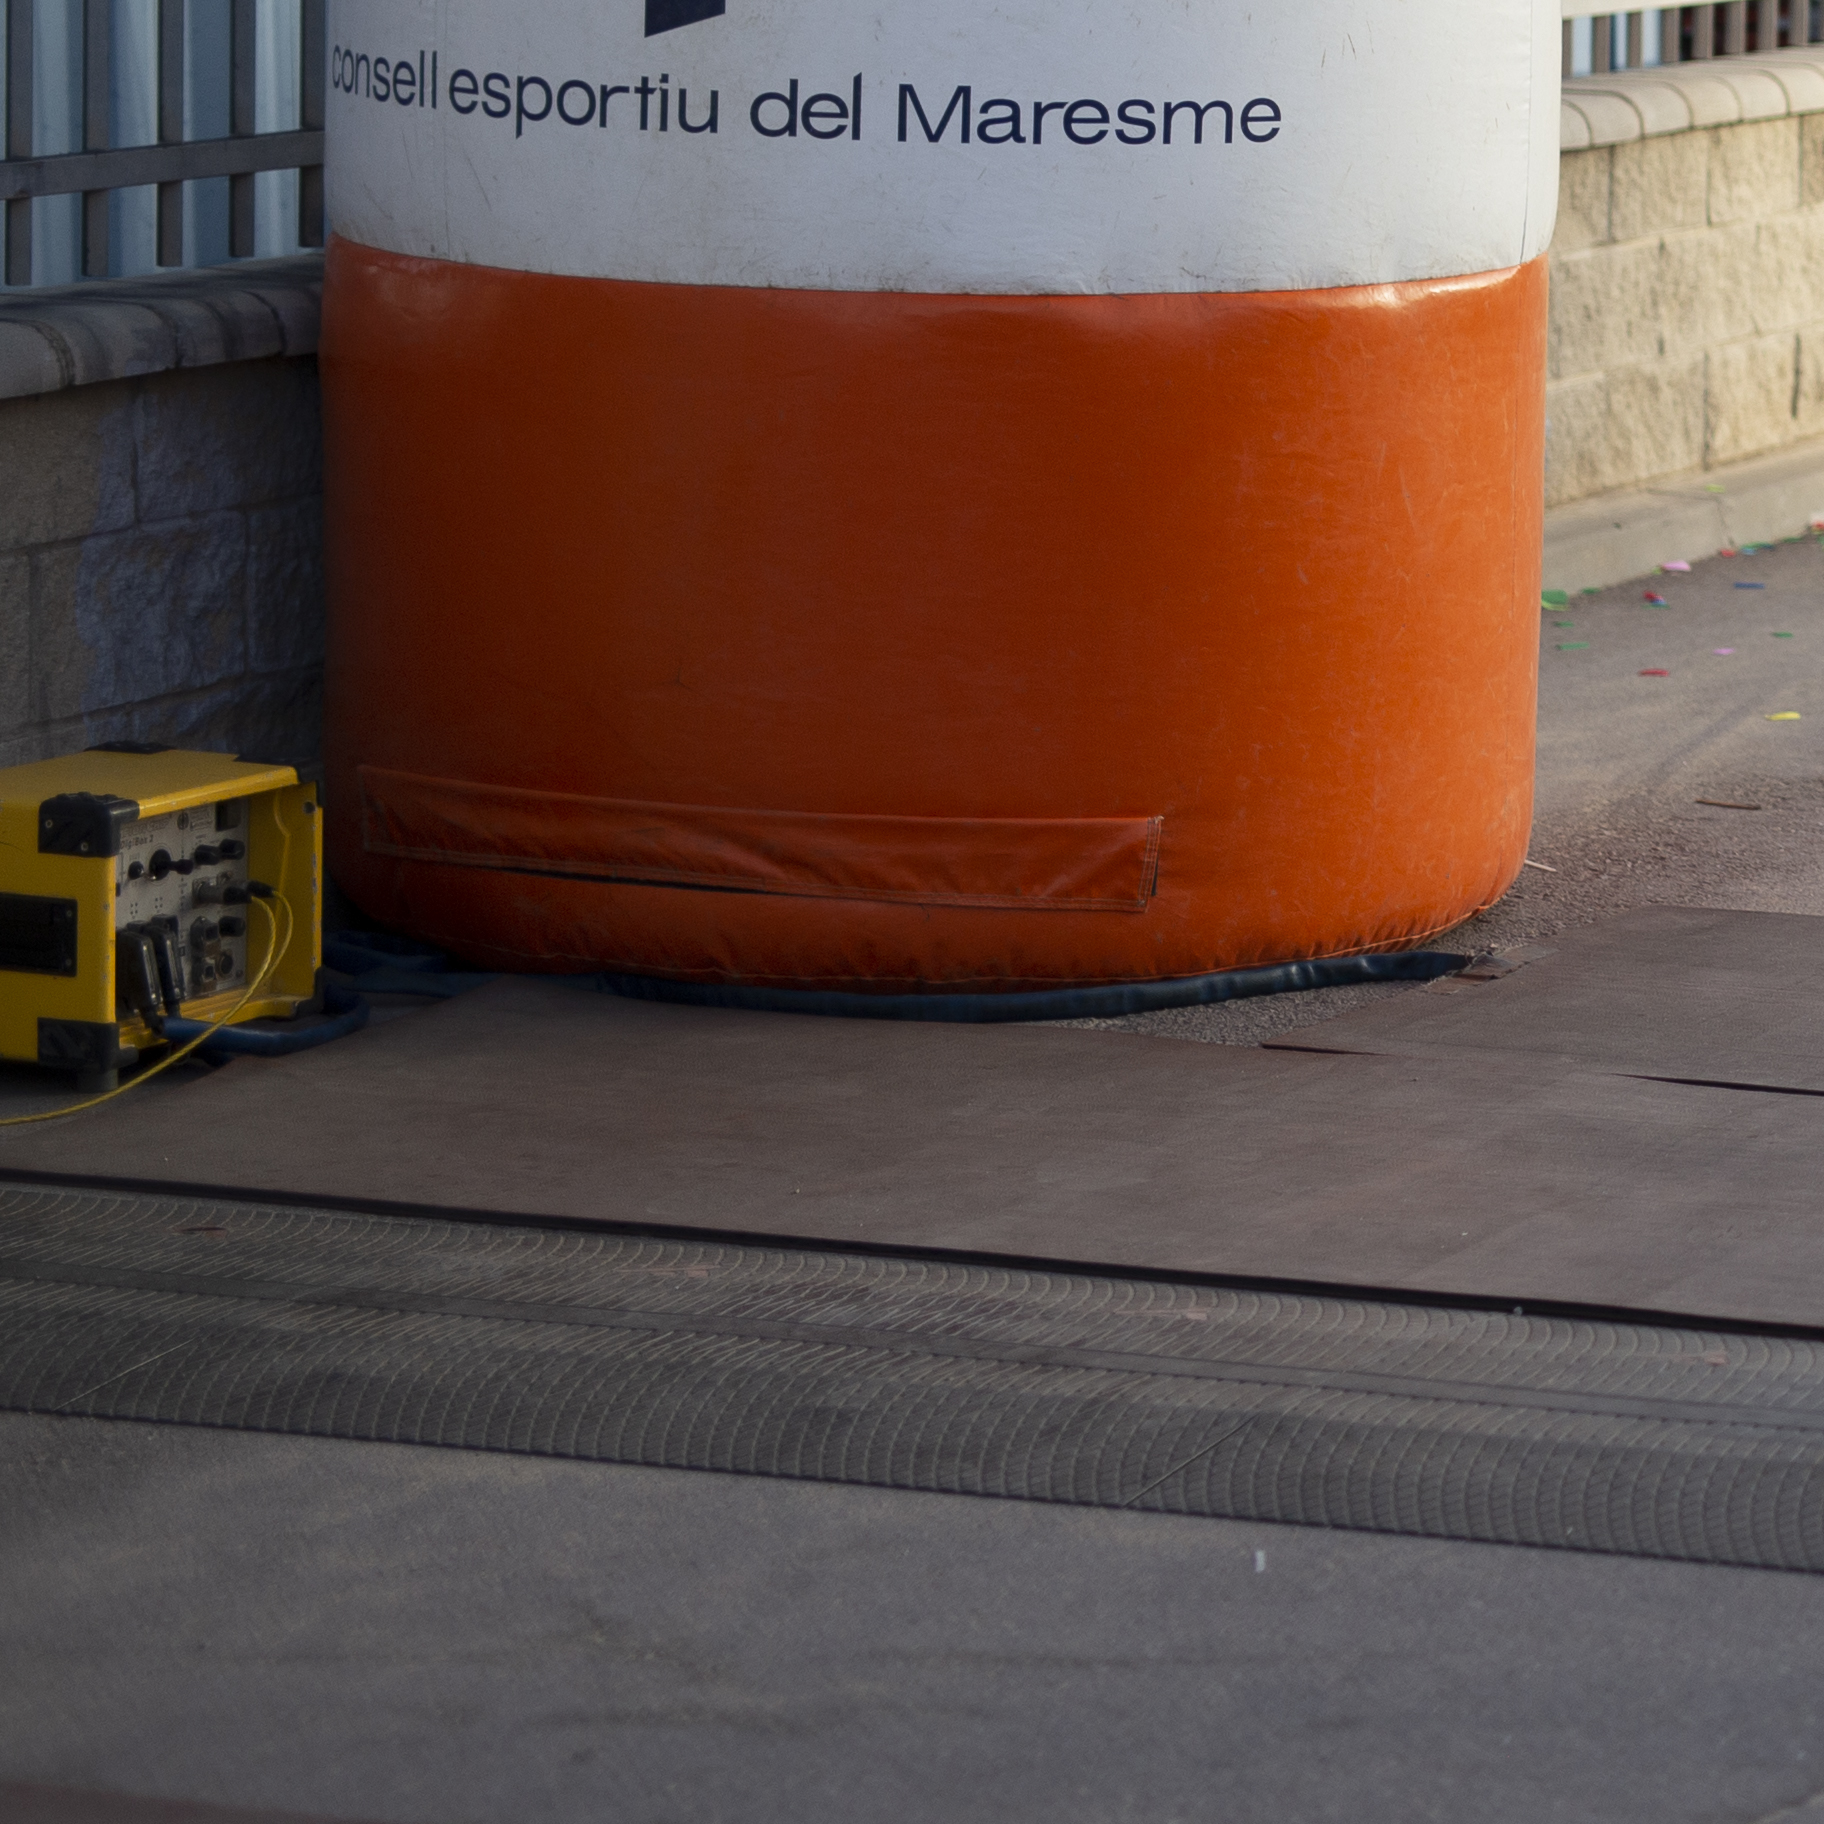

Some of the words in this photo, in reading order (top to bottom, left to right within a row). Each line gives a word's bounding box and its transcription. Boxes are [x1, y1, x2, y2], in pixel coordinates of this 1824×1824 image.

[331, 42, 438, 110] consell
[448, 68, 719, 140] esportiu
[749, 71, 863, 142] del
[897, 83, 1283, 146] Maresme
